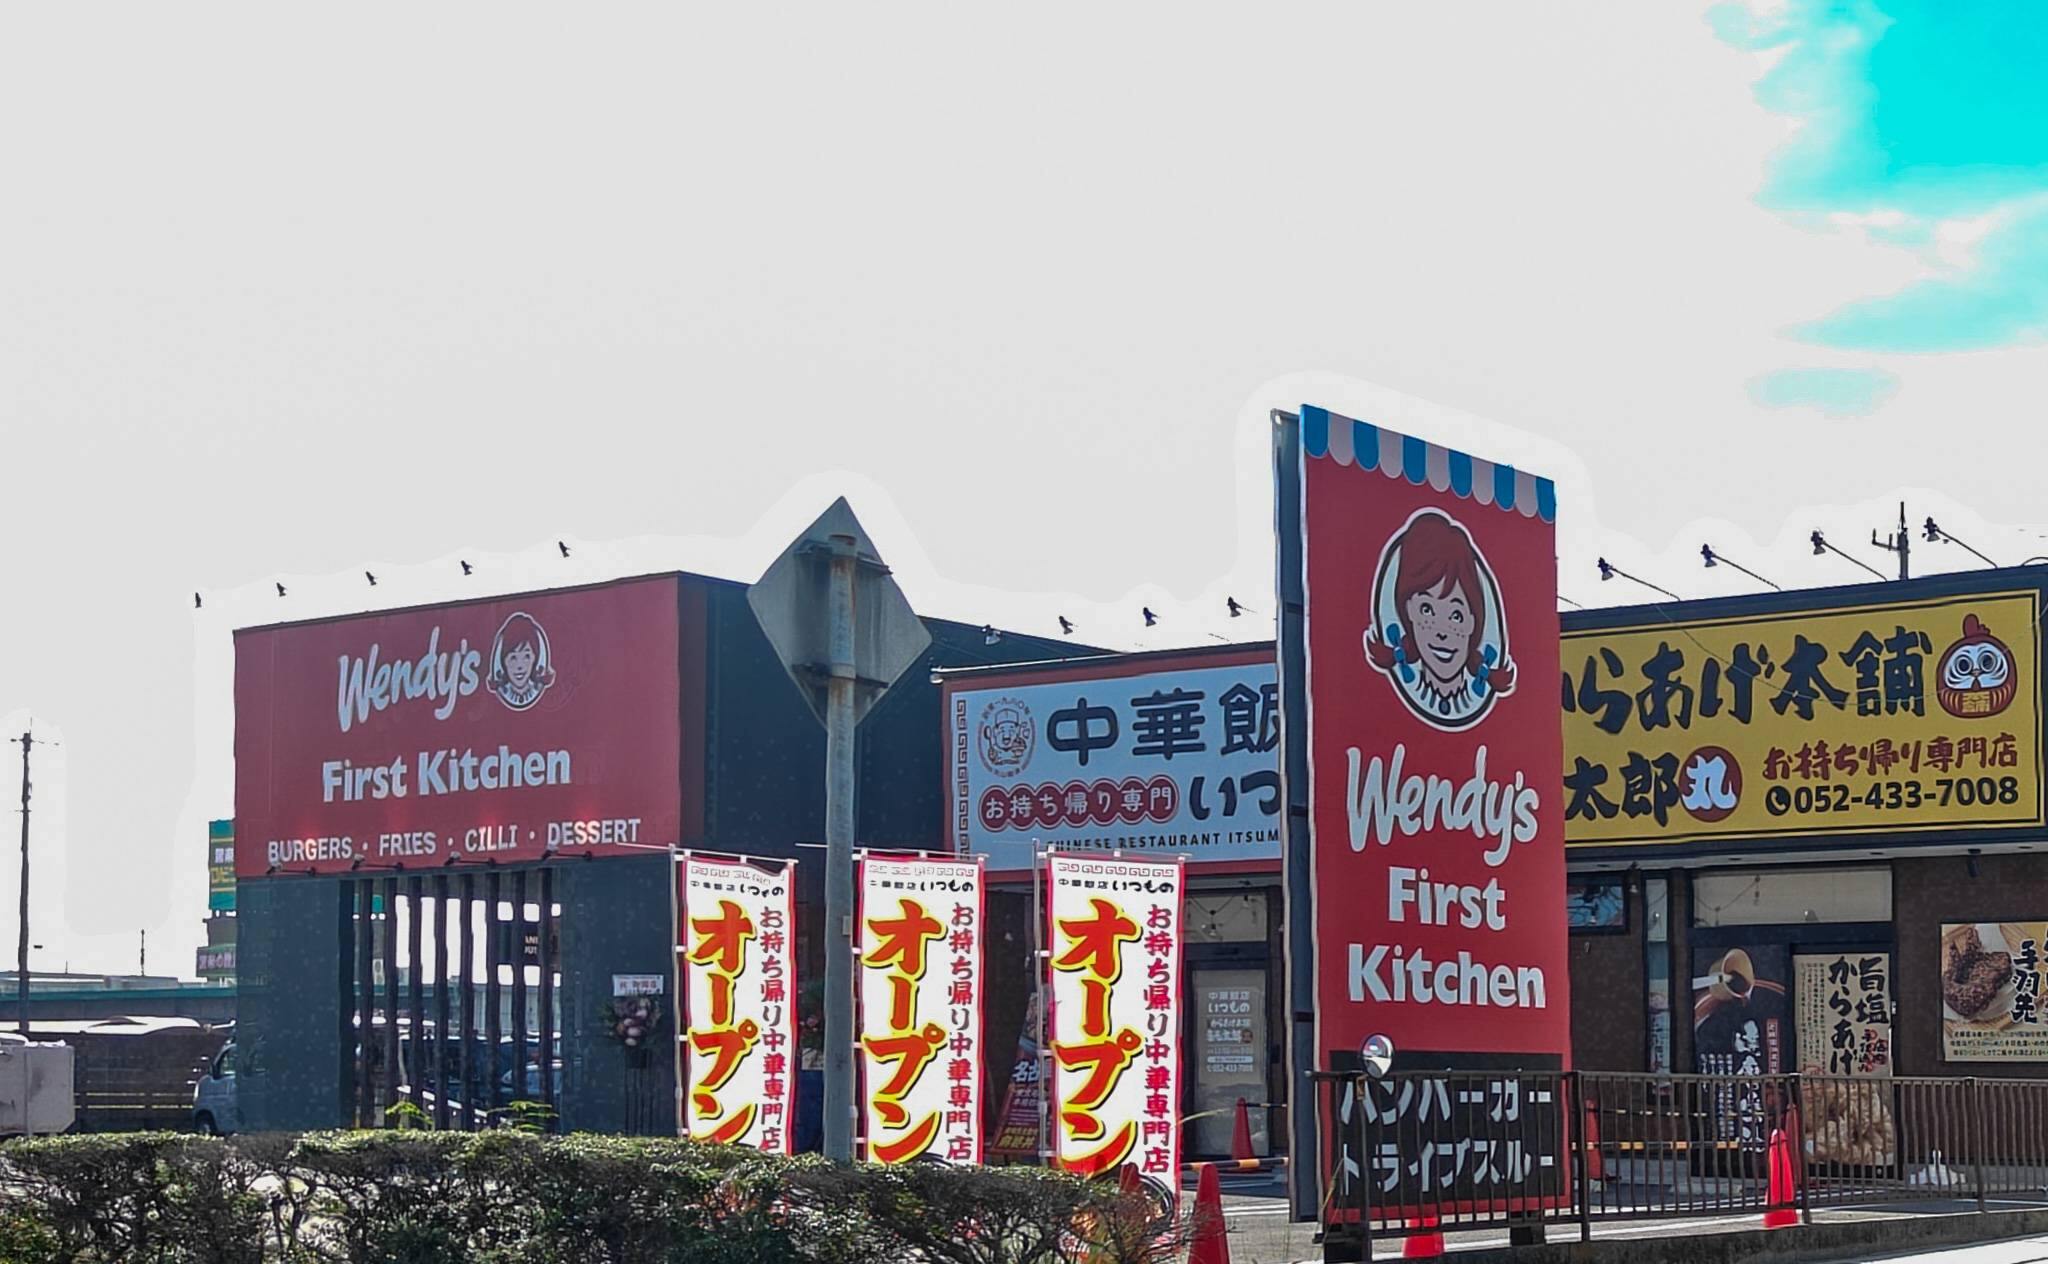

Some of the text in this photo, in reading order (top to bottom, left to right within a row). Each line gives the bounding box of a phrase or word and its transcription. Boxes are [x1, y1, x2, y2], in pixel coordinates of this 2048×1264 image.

[338, 626, 480, 732] Wendy's
[1047, 682, 1280, 766] 中華飯
[1762, 731, 2017, 781] お持ち帰り専門店
[323, 745, 571, 803] First Kitchen
[985, 786, 1172, 820] お持ち帰り専門
[1189, 770, 1281, 820] いつ
[1346, 743, 1539, 867] Wendy's
[1563, 751, 1738, 828] 太郎丸
[1795, 776, 2019, 814] 052-433-7008
[268, 818, 641, 863] BURGERS FRIES CILLI DESSERT
[1119, 832, 1221, 849] RESTAURANT
[1228, 829, 1279, 844] ITSUM
[1388, 866, 1506, 931] First
[1348, 943, 1547, 1009] Kitchen
[1828, 955, 1858, 1076] からあげ
[1855, 956, 1889, 1025] 旨塩
[2011, 940, 2041, 1024] 手羽先
[687, 899, 757, 1144] オープン
[759, 905, 787, 1150] お持ち帰り中華専門店
[862, 899, 946, 1165] オープン
[945, 902, 975, 1161] お持ち帰り中華専門店
[1052, 898, 1141, 1176] オープン
[1141, 903, 1174, 1174] お持ち帰り中華専門店
